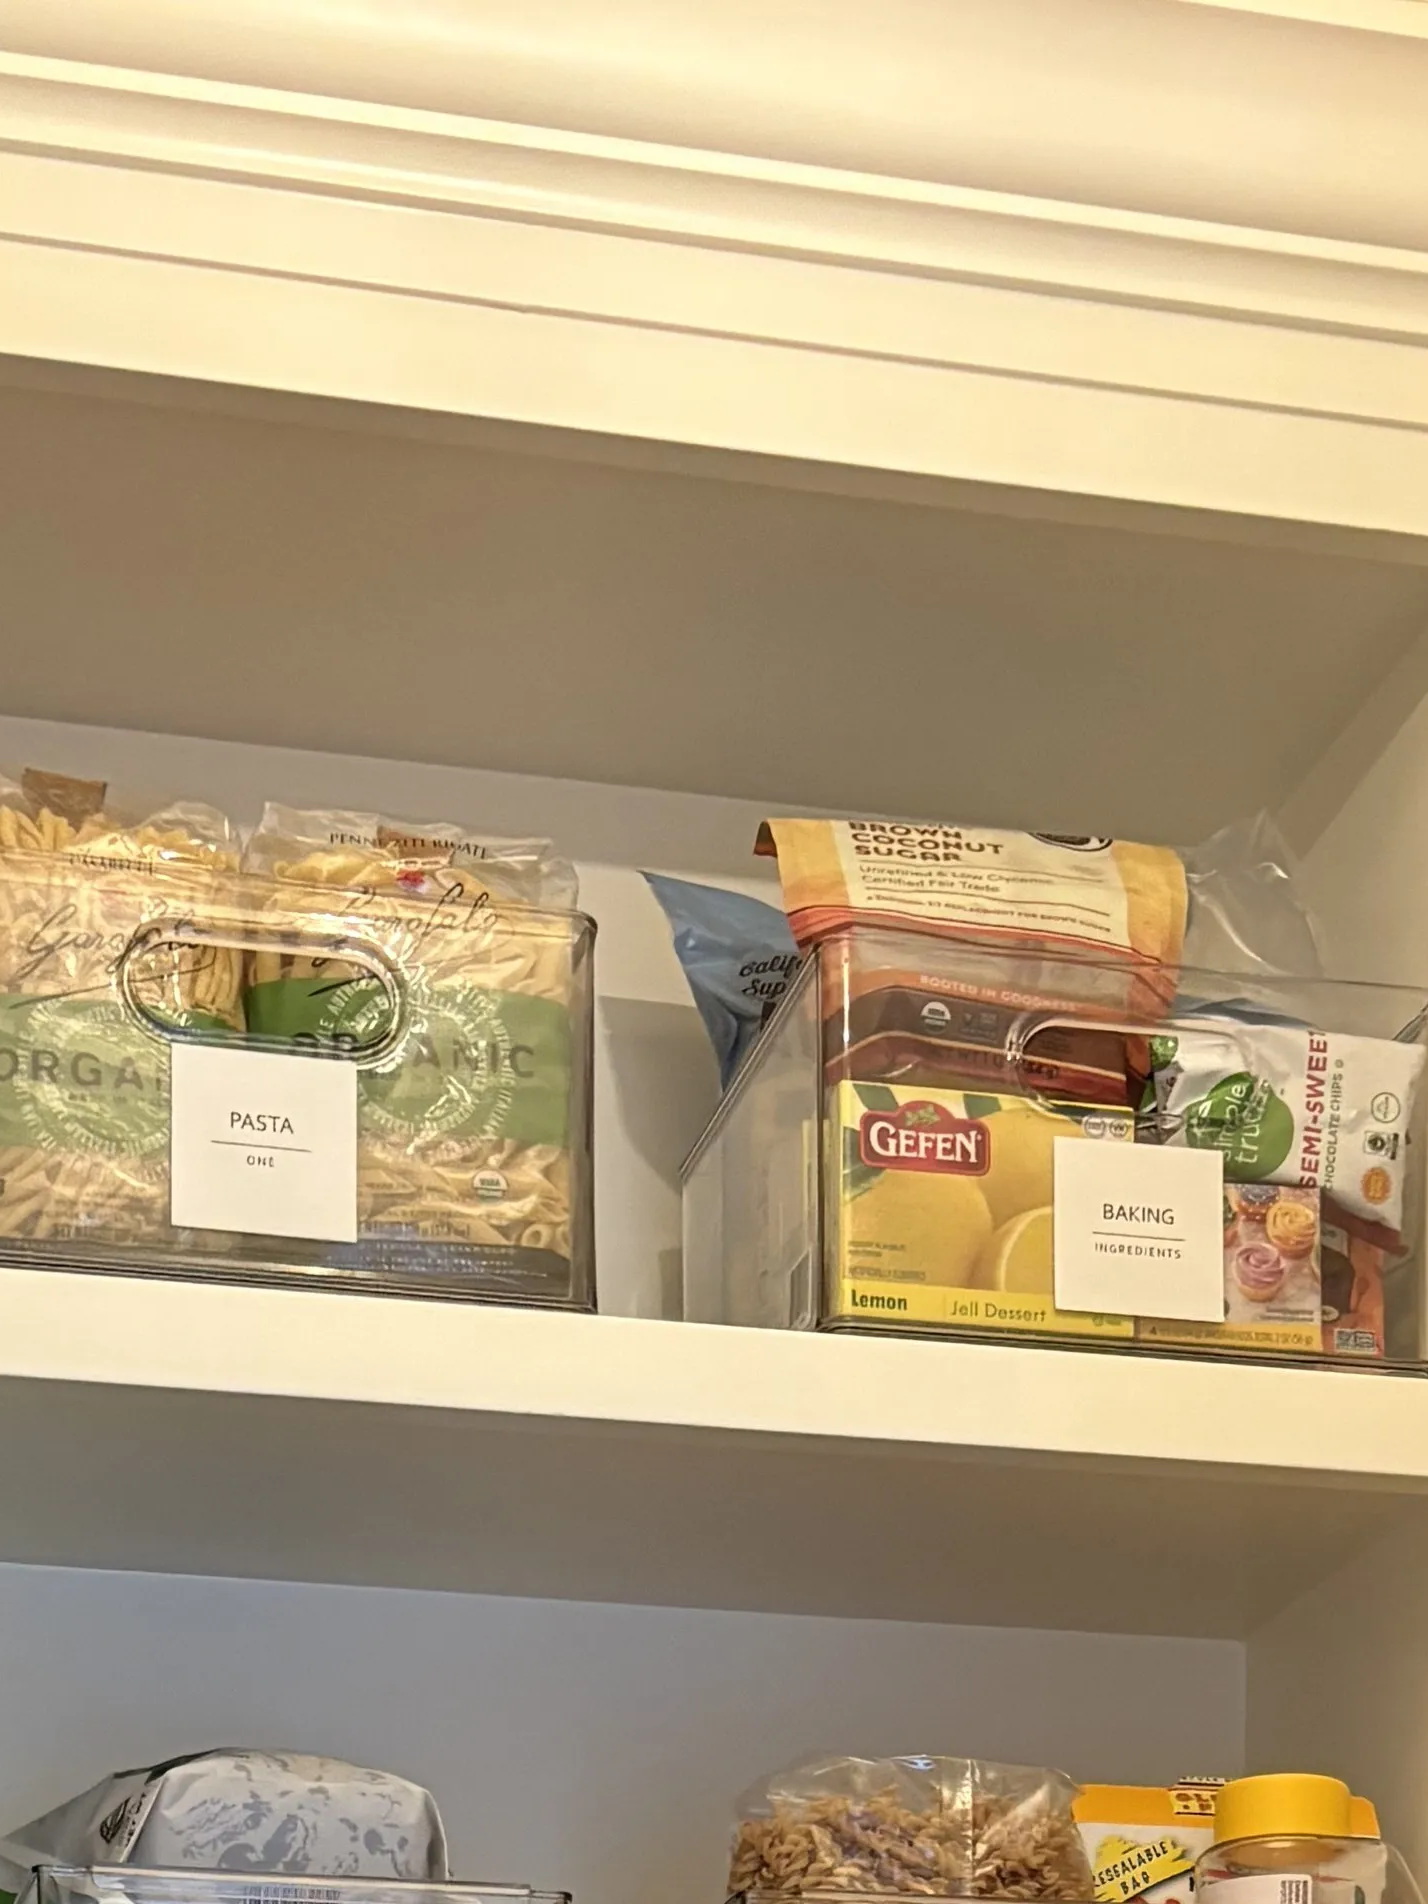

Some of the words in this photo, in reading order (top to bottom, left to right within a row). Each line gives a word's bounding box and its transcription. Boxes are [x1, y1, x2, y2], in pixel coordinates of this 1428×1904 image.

[852, 833, 1003, 855] COCONUT
[853, 845, 961, 862] SUGAR
[919, 974, 979, 997] ROOTED
[230, 1111, 296, 1136] PASTA
[870, 1121, 980, 1164] GEFEN
[246, 1153, 277, 1167] ONE
[1103, 1203, 1175, 1226] BAKING
[1094, 1241, 1182, 1260] INGREDIENTS
[850, 1288, 909, 1312] Lemon
[950, 1299, 979, 1319] Jell
[984, 1303, 1048, 1323] Dessert
[1121, 1872, 1151, 1896] BAG
